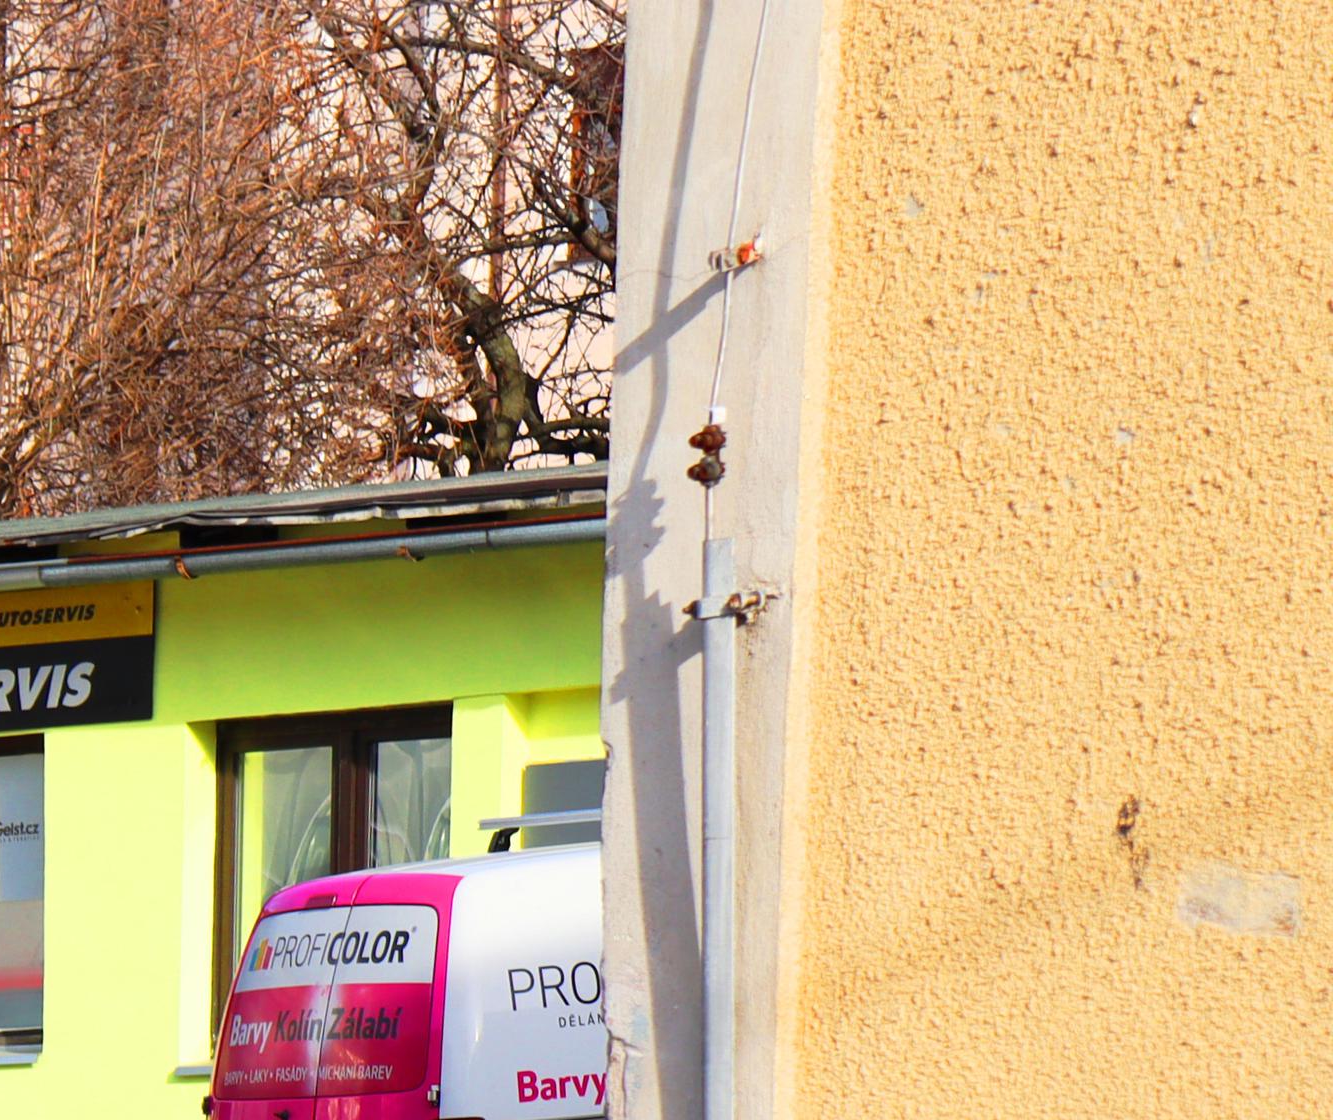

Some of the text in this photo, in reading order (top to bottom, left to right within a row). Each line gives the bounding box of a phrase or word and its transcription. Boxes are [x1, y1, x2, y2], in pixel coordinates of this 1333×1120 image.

[269, 929, 411, 970] PROFICOLOR
[507, 961, 601, 1012] PRO
[229, 1006, 405, 1054] Barvy Kolín Zálabí
[249, 1068, 269, 1084] LAKY
[275, 1065, 309, 1083] FASÁDY
[358, 1065, 394, 1081] BAREV
[516, 1070, 607, 1105] Barvy
